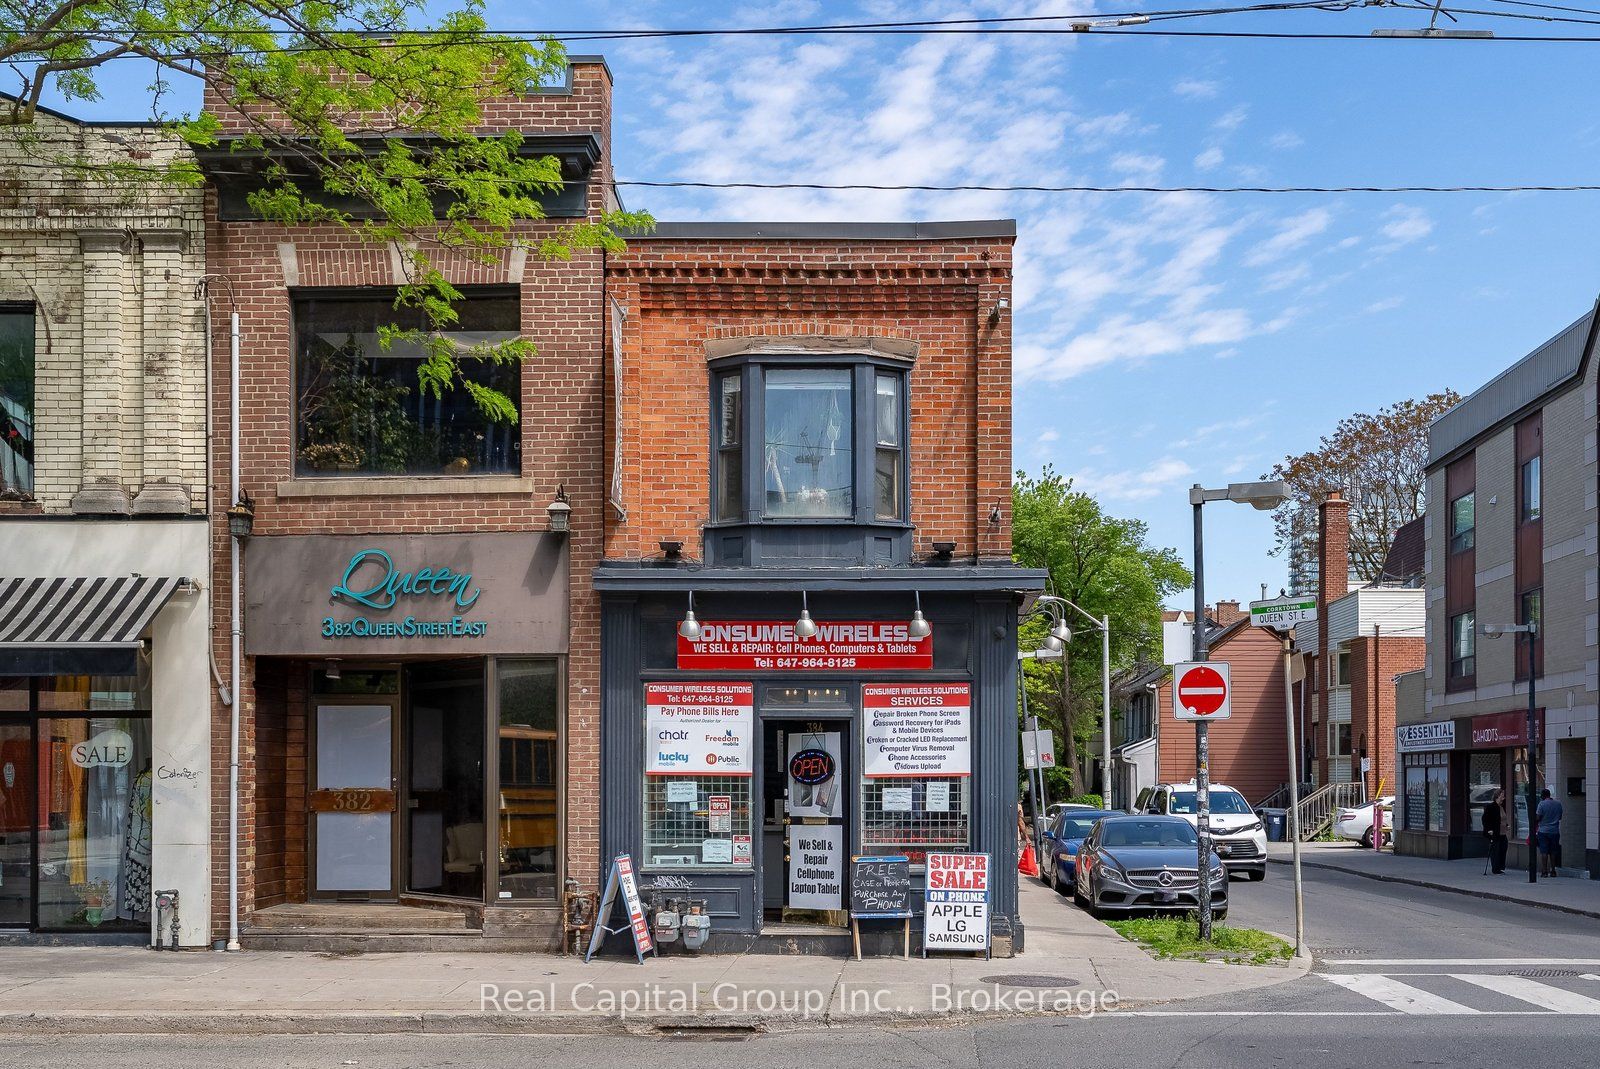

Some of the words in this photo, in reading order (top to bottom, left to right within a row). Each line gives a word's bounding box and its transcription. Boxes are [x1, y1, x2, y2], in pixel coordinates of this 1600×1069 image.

[330, 548, 480, 609] Queen
[1266, 604, 1300, 613] CORKTOWN
[1259, 612, 1284, 623] QUEEN
[687, 625, 808, 642] ONSUME
[815, 625, 924, 642] WIRELES
[693, 643, 707, 653] WE
[709, 643, 730, 653] SELL
[732, 643, 739, 653] &
[741, 643, 774, 653] REPAIR:
[776, 643, 792, 653] Cell
[794, 643, 828, 655] Phones,
[829, 643, 876, 655] Computers
[877, 643, 884, 653] &
[886, 643, 917, 653] Tablets
[754, 657, 774, 667] Tel:
[776, 657, 856, 667] 647-964-8125
[648, 685, 684, 693] CONSUMER
[684, 685, 716, 693] WIRELESS
[716, 686, 752, 694] SOLUTIONS
[865, 687, 900, 695] CONSUMER
[901, 687, 933, 695] WIRELESS
[933, 687, 969, 695] SOLUTIONS
[667, 694, 681, 703] Tel:
[682, 694, 734, 703] 647-964-8125
[890, 696, 944, 706] SERVICES
[661, 706, 675, 717] Pay
[677, 706, 701, 716] Phone
[702, 706, 719, 716] Bills
[721, 707, 739, 716] Here
[806, 722, 823, 733] 384
[905, 719, 933, 727] Recovery
[658, 729, 689, 741] chatr
[1407, 722, 1454, 740] ESSENTIAL
[1472, 728, 1498, 743] CAHOOTS
[705, 734, 739, 742] Freedom
[931, 735, 968, 744] Replacement
[75, 746, 128, 764] SALE
[658, 751, 689, 763] lucky
[717, 755, 740, 763] Public
[910, 753, 947, 761] Accessories
[793, 757, 829, 777] OPEN
[920, 762, 942, 770] Upload
[333, 792, 371, 810] 382
[712, 802, 728, 810] OPEN
[798, 839, 811, 850] We
[811, 839, 827, 851] Sell
[827, 841, 834, 851] &
[803, 853, 829, 866] Repair
[930, 855, 986, 870] SUPER
[797, 867, 835, 880] Cellphone
[856, 863, 898, 877] FREE
[852, 879, 875, 888] CASE
[930, 870, 986, 889] SALE
[791, 882, 817, 895] Laptop
[817, 882, 840, 895] Tablet
[930, 891, 945, 901] ON
[948, 891, 985, 902] PHONE
[861, 898, 903, 910] PHONE
[931, 904, 983, 918] APPLE
[947, 919, 967, 932] LG
[928, 933, 985, 943] SAMSUNG
